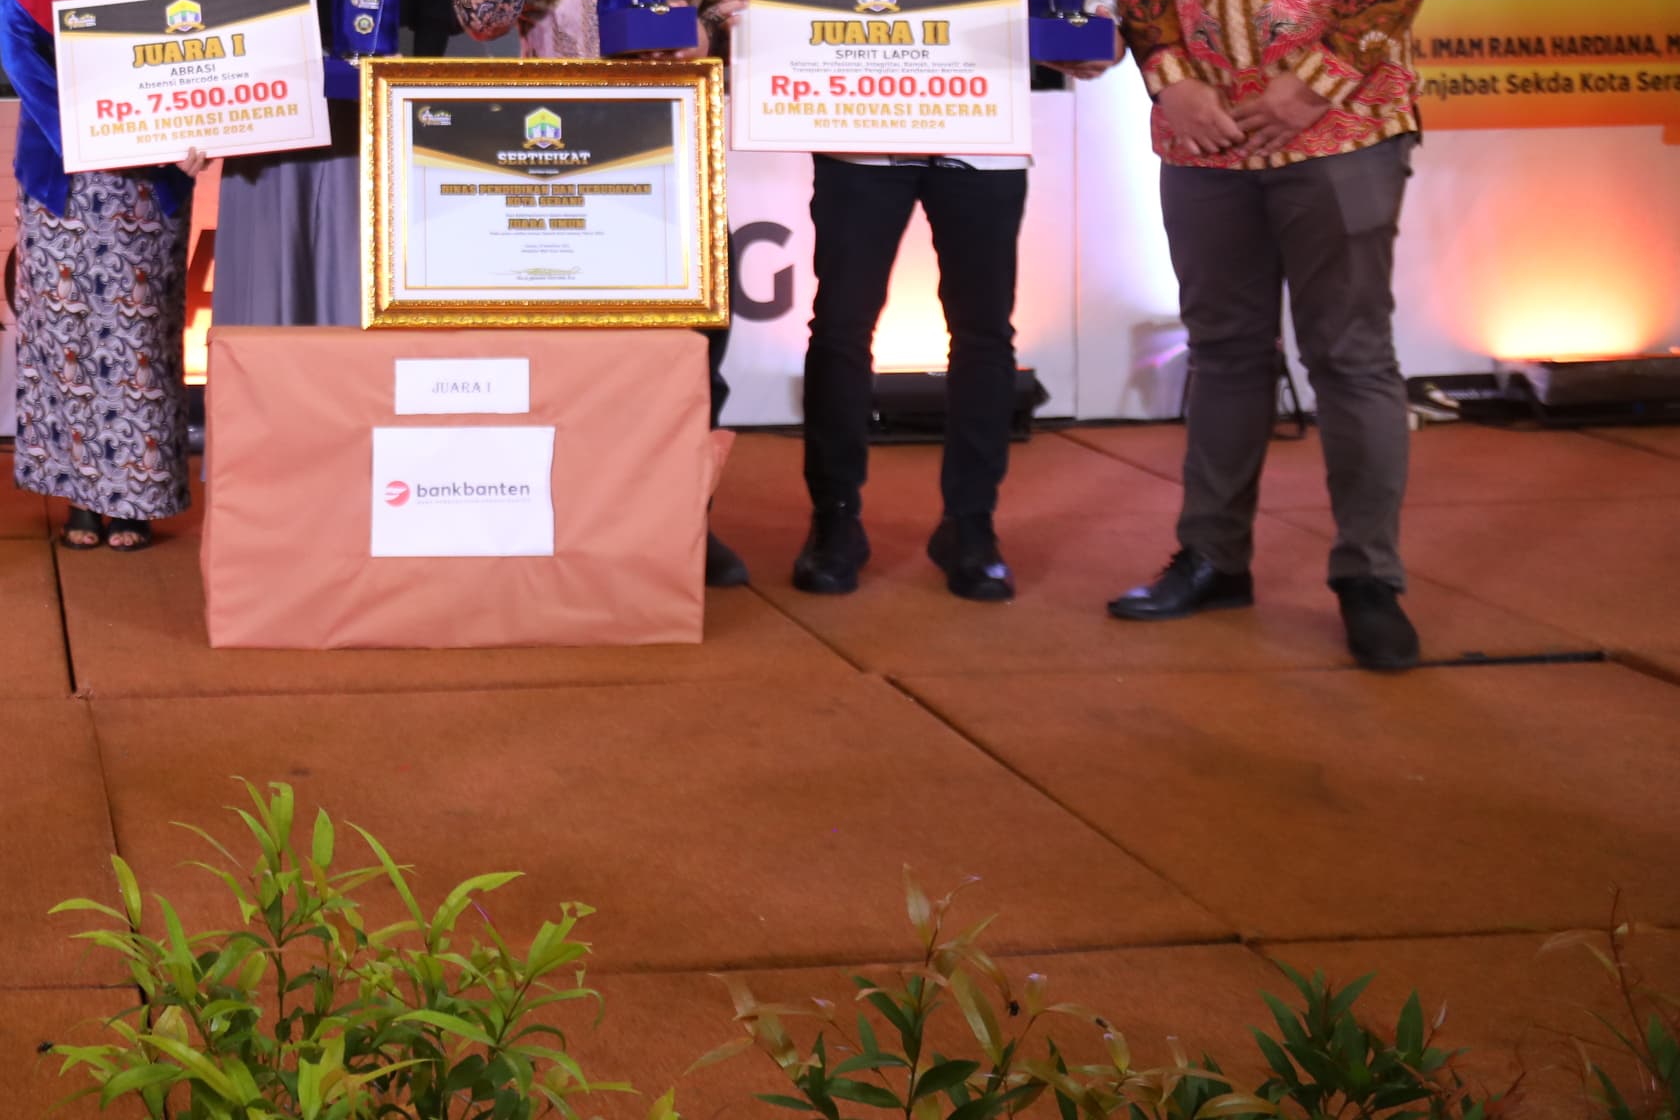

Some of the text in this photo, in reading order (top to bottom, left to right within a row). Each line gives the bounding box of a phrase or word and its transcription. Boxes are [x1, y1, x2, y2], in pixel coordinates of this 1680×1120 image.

[810, 19, 950, 46] JUARA II
[132, 33, 246, 68] JUARA I
[835, 49, 930, 61] SPIRIT LAPOR
[1432, 36, 1484, 59] IMAM
[1490, 36, 1547, 58] RANA
[170, 64, 216, 78] ABRASI
[179, 74, 219, 86] Barcode
[221, 70, 250, 82] Siswa
[771, 75, 988, 102] Rp. 5.000.000
[1506, 72, 1574, 94] Sekda
[1581, 72, 1631, 93] Kota
[96, 79, 289, 123] Rp. 7.500.000
[762, 102, 998, 117] LOMBA INOVASI DAERAH
[90, 103, 299, 138] LOMBA INOVASI DAERAH
[814, 119, 946, 129] KOTA SERANG 2024
[136, 123, 255, 144] KOTA SERANG 2024
[496, 150, 591, 166] SERTIFIKAT
[431, 381, 482, 394] JUARA
[416, 482, 531, 498] bankbanten
